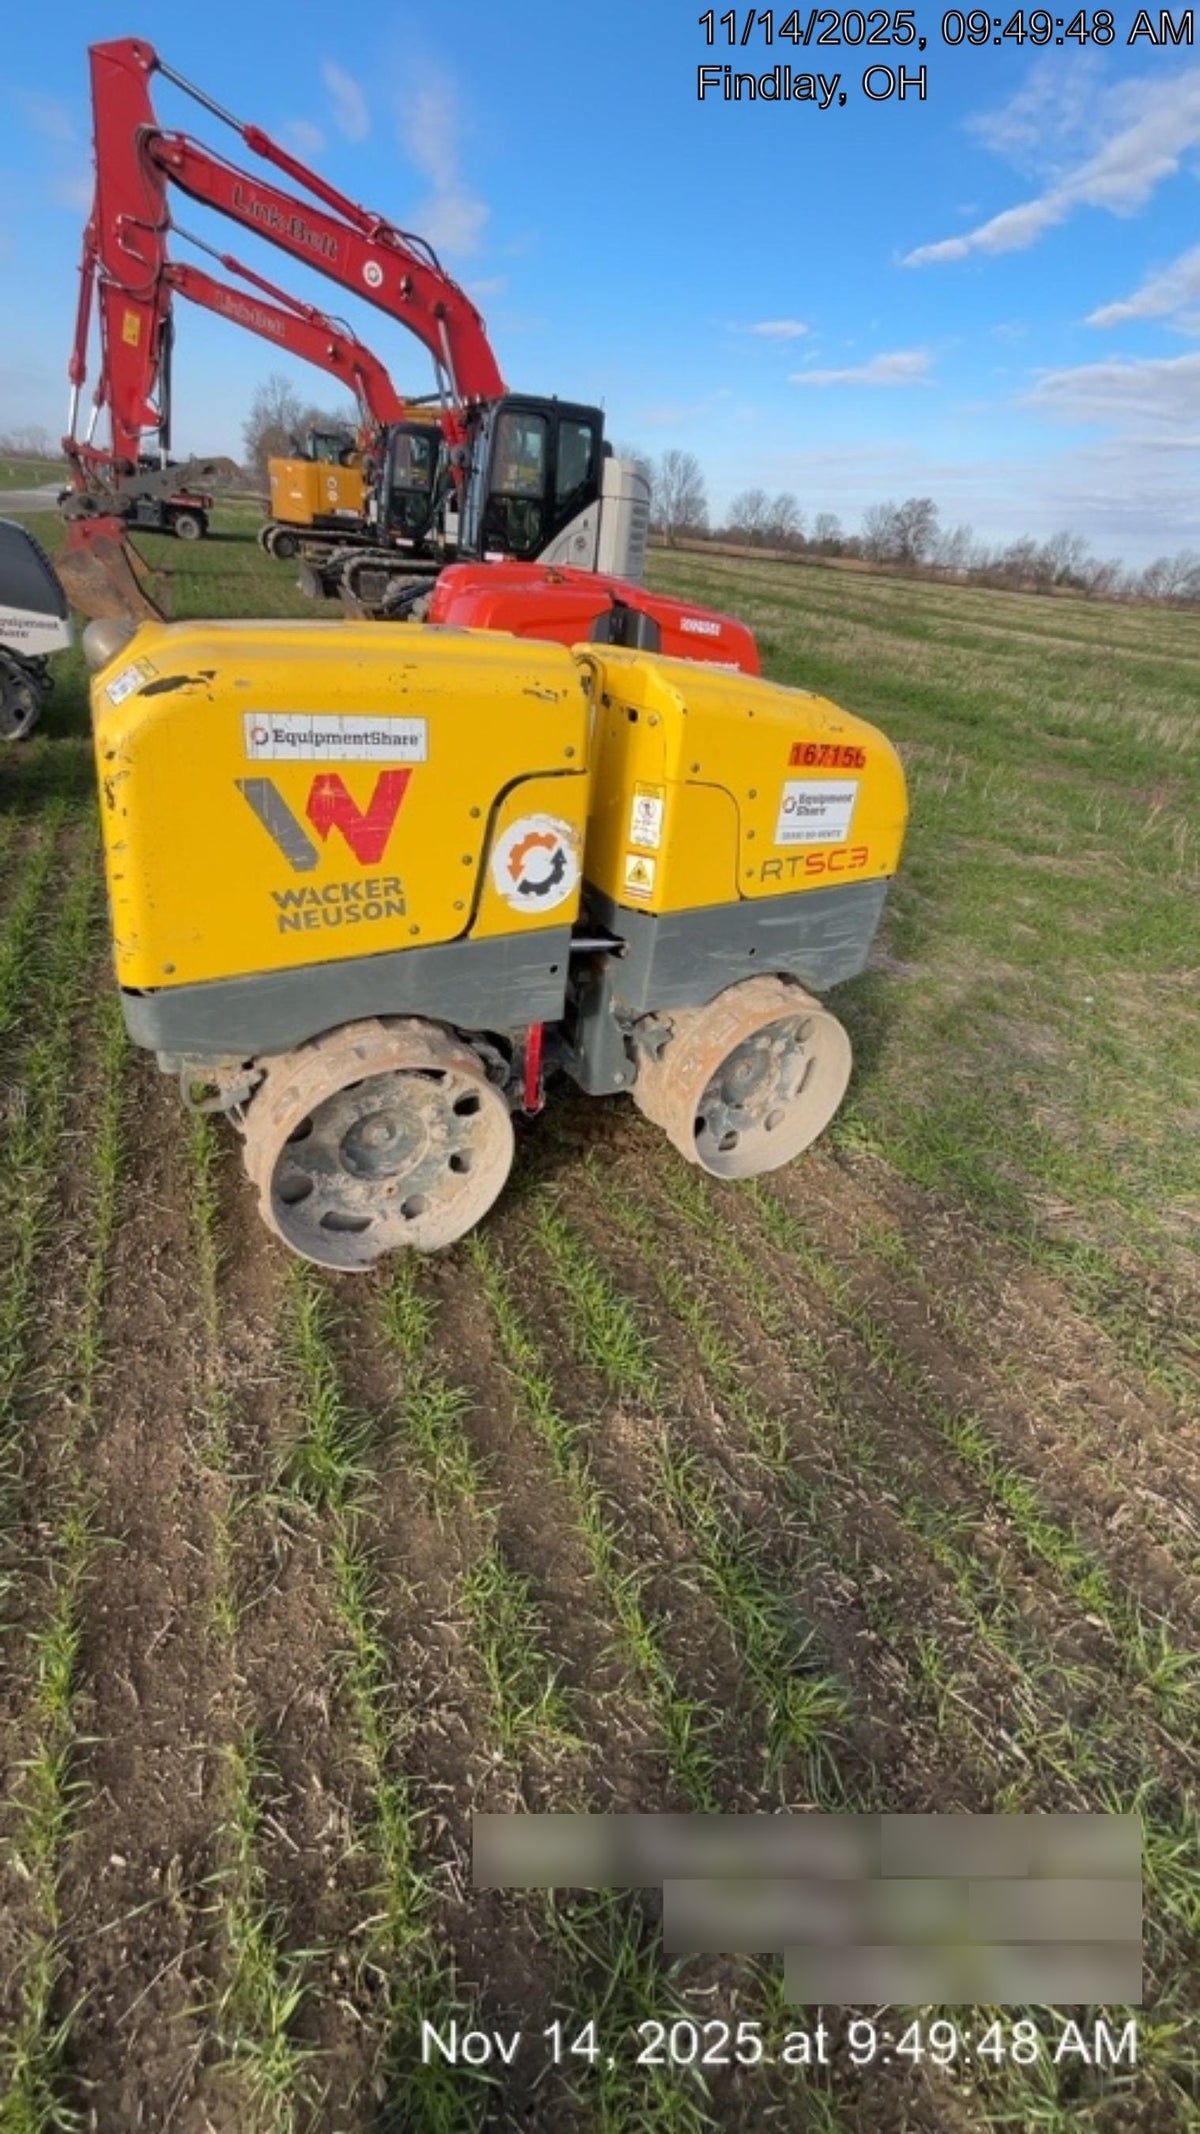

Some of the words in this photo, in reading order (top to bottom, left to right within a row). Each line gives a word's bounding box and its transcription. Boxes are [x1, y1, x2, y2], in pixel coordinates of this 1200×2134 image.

[272, 729, 419, 748] EquipmentShare
[270, 877, 405, 911] WACKER
[277, 898, 408, 935] NEUSON
